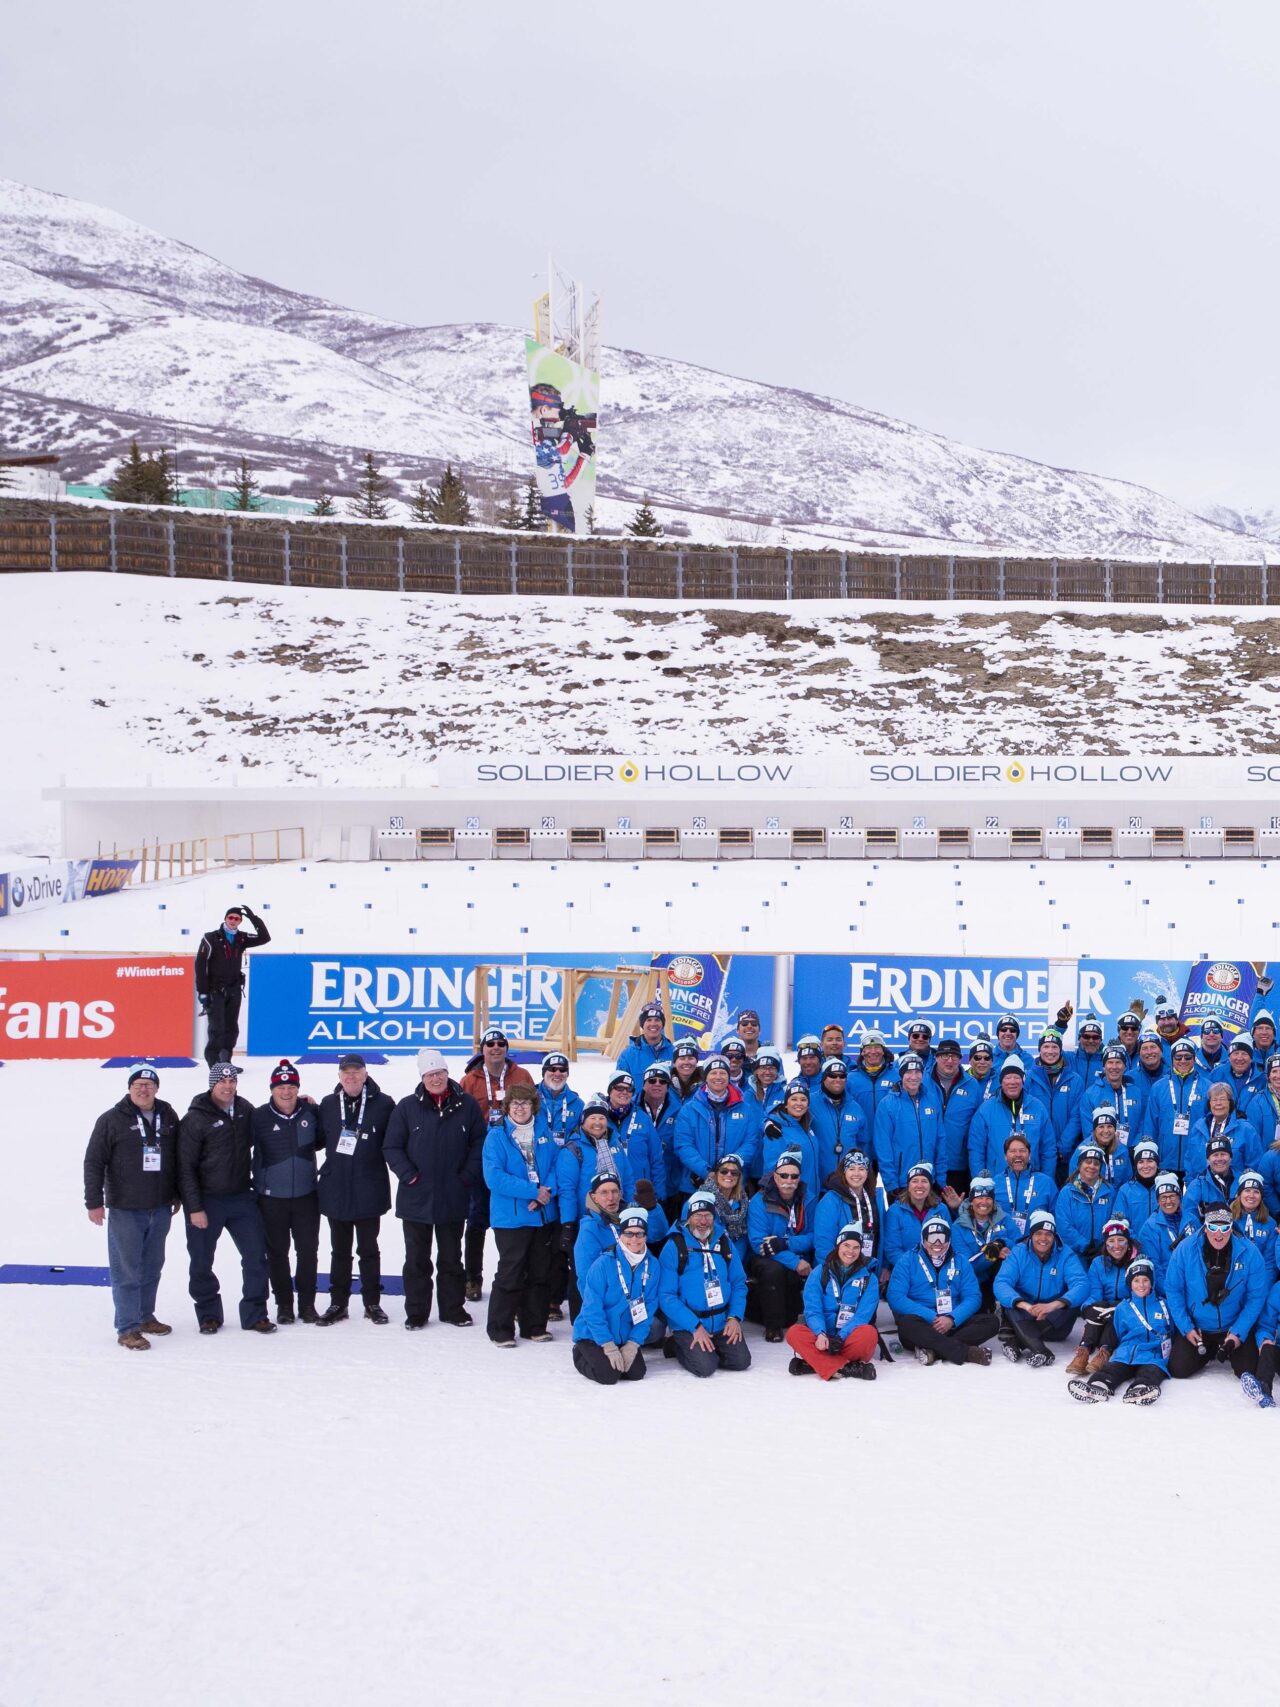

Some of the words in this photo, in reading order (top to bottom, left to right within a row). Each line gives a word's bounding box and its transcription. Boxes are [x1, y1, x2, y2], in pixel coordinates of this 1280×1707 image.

[478, 764, 614, 781] SOLDIER
[646, 764, 793, 781] HOLLOW
[870, 765, 1000, 782] SOLDIER
[1031, 765, 1173, 782] HOLLOW
[391, 818, 403, 829] 30
[467, 818, 480, 829] 29
[542, 818, 555, 829] 28
[618, 818, 630, 829] 27
[693, 818, 706, 829] 26
[767, 818, 779, 829] 25
[841, 817, 853, 828] 24
[914, 817, 926, 828] 23
[987, 817, 998, 828] 22
[1059, 817, 1070, 828] 21
[1130, 817, 1142, 828] 20
[1201, 817, 1213, 828] 19
[27, 875, 62, 902] xDrive
[116, 965, 185, 978] #Winterfans
[309, 961, 562, 1014] ERDINGER
[849, 962, 1112, 1015] ERDINGER
[655, 988, 713, 1013] RINGER
[1186, 992, 1250, 1018] ERDINGER
[1184, 1006, 1248, 1024] ALKOHOLFREI
[308, 1019, 551, 1040] ALKOHOLRE
